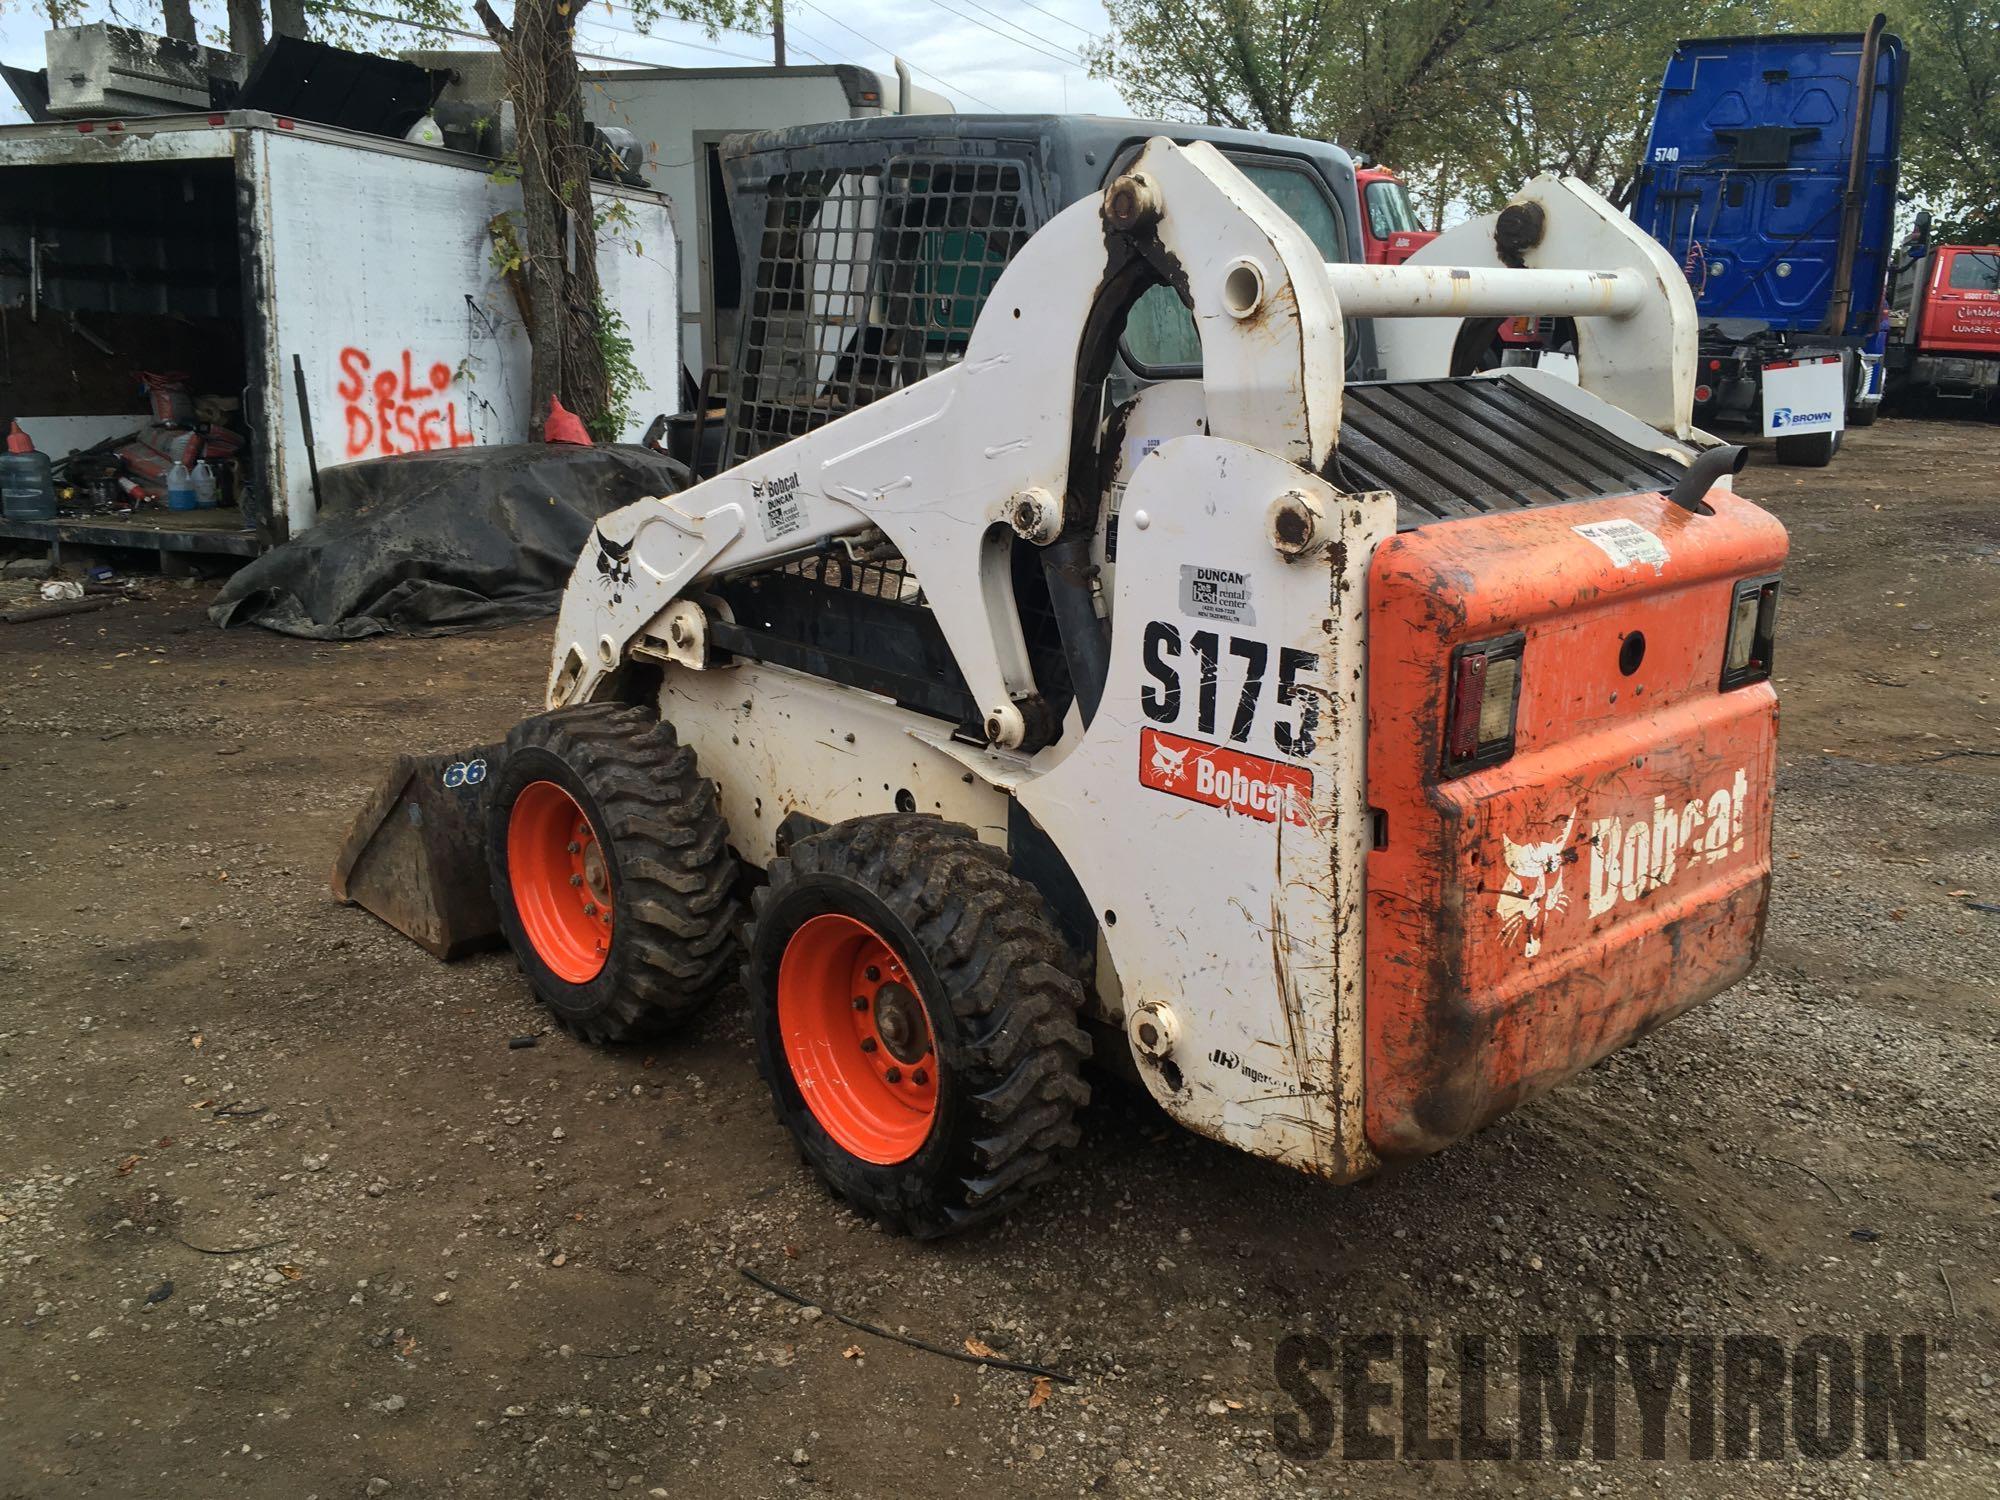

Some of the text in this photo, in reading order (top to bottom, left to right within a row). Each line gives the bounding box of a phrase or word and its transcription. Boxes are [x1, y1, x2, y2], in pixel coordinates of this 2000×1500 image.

[1654, 147, 1679, 162] 5740
[1952, 324, 1992, 334] LUMBER
[1792, 411, 1832, 423] BROWN
[768, 471, 800, 498] Bobcat
[768, 493, 793, 510] DUNCAN
[1198, 569, 1243, 584] DUNCAN
[1193, 584, 1217, 604] best
[1219, 590, 1244, 600] rental
[1219, 599, 1247, 609] center
[1141, 620, 1320, 758] S175
[443, 758, 487, 788] 66
[1196, 758, 1298, 820] Bobcat
[1588, 768, 1748, 920] Bobcat
